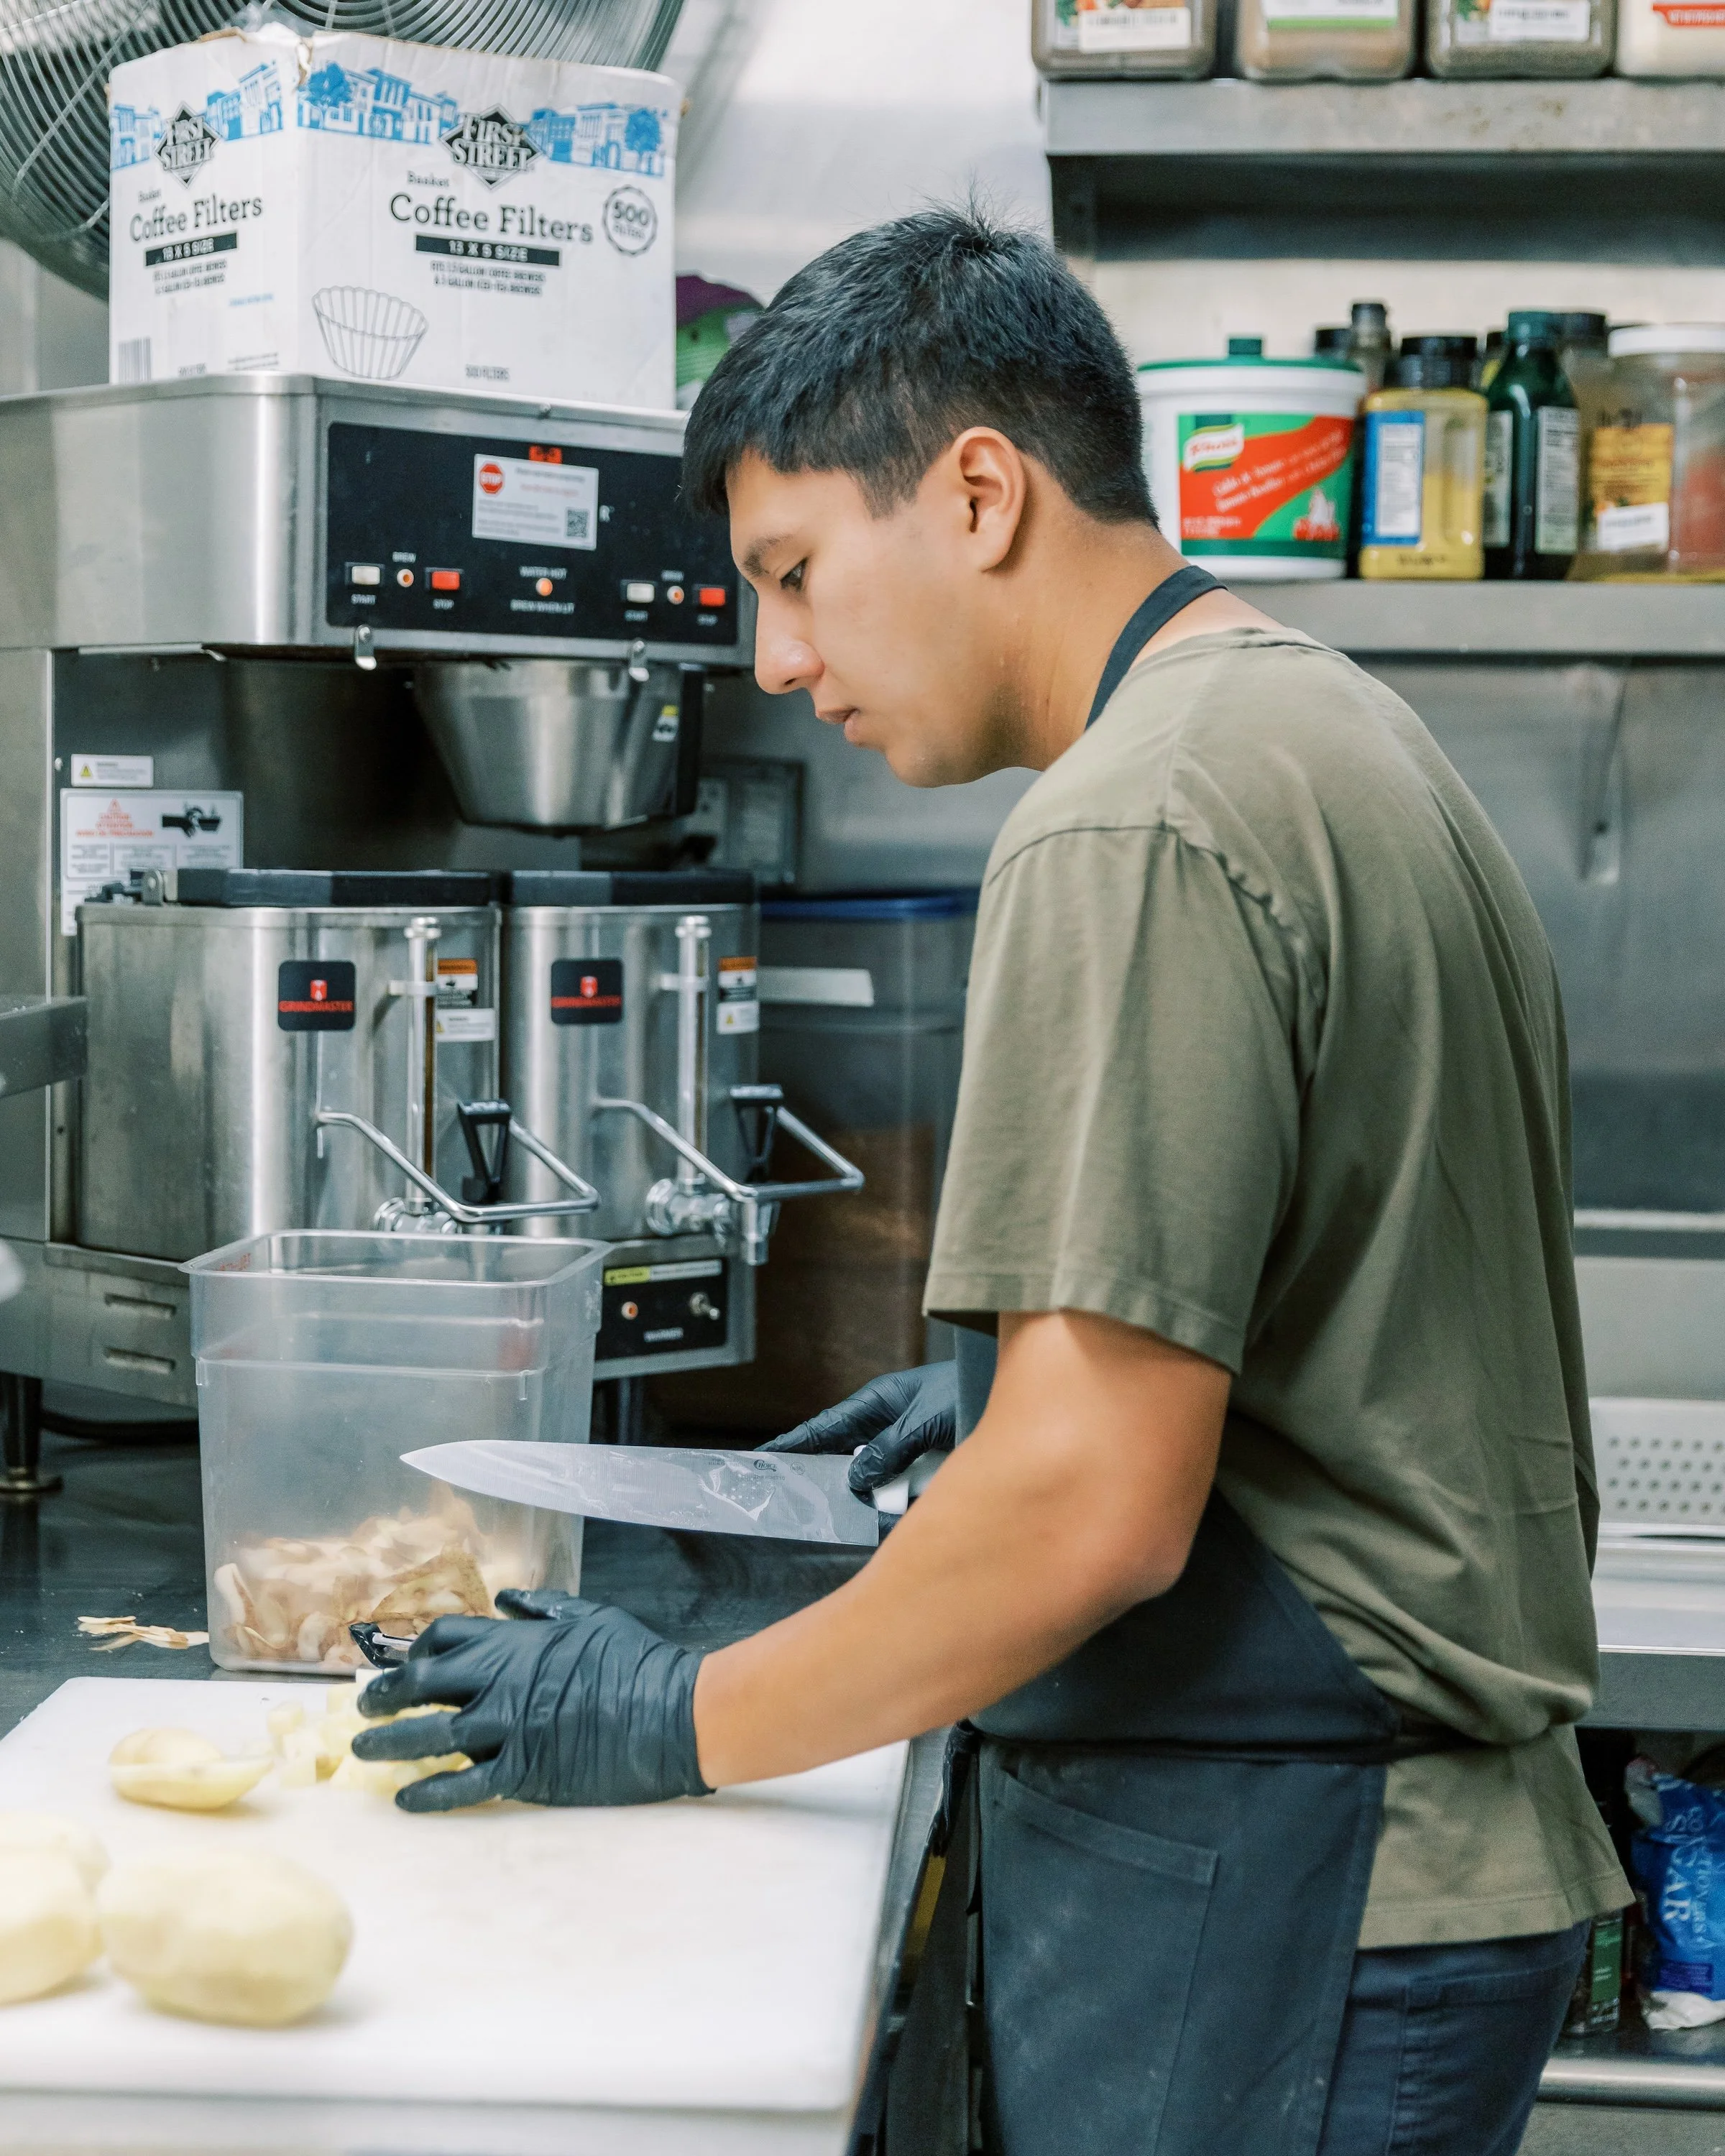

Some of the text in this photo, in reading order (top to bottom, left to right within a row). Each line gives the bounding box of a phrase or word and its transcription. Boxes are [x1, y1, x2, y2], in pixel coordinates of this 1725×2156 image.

[165, 116, 204, 146] FIRST
[460, 113, 524, 147] FIRST
[160, 137, 212, 170] STREET
[451, 138, 532, 170] STREET
[408, 171, 450, 187] Basket
[130, 194, 262, 241] Coffee Filters
[390, 193, 593, 243] Coffee Filters
[614, 201, 648, 225] 500
[175, 244, 183, 259] X
[448, 240, 464, 255] 13
[468, 241, 479, 257] X
[495, 245, 528, 262] SIZE
[480, 473, 502, 484] STOP
[392, 551, 416, 563] BREW
[520, 566, 548, 578] WATER
[351, 594, 377, 605] START
[432, 599, 454, 609] STOP
